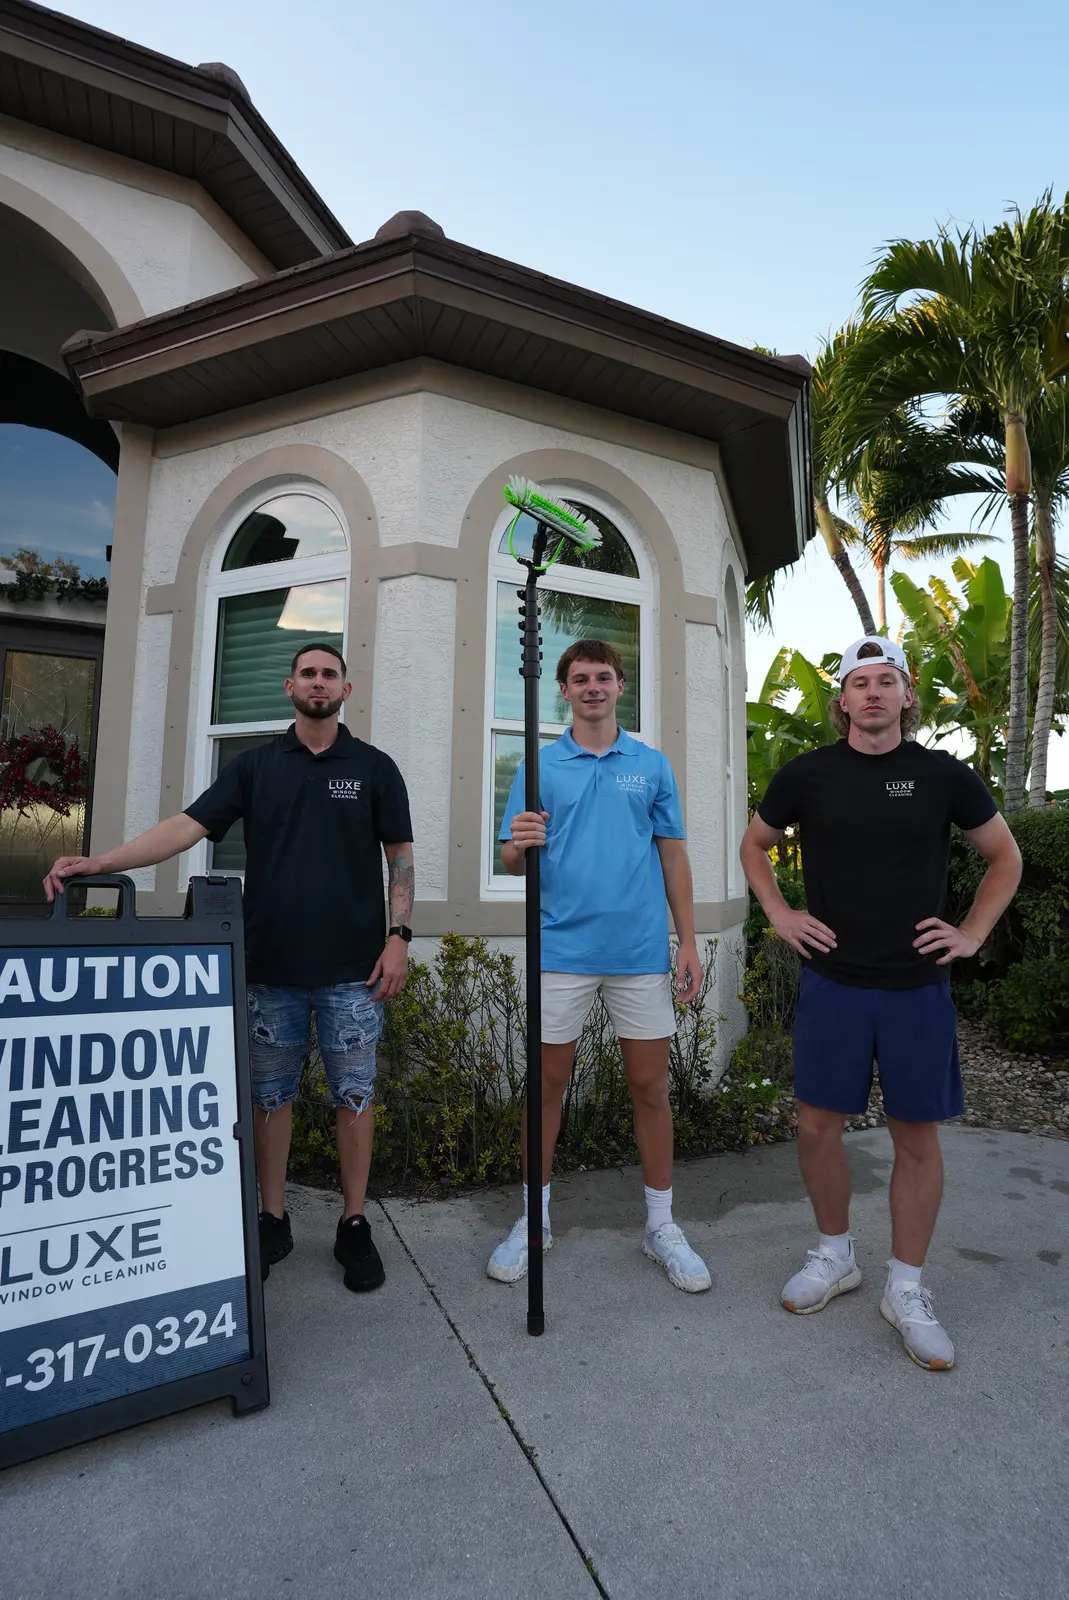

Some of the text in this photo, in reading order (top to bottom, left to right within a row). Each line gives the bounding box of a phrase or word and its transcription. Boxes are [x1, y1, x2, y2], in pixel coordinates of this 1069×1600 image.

[329, 781, 361, 790] LUXE
[617, 774, 646, 785] LUXE
[886, 782, 915, 790] LUXE
[0, 1081, 220, 1156] EANING
[0, 1137, 224, 1208] PROGRESS
[0, 1218, 162, 1287] LUXE
[82, 1259, 167, 1287] CLEANING
[0, 1302, 237, 1392] -317-0324
